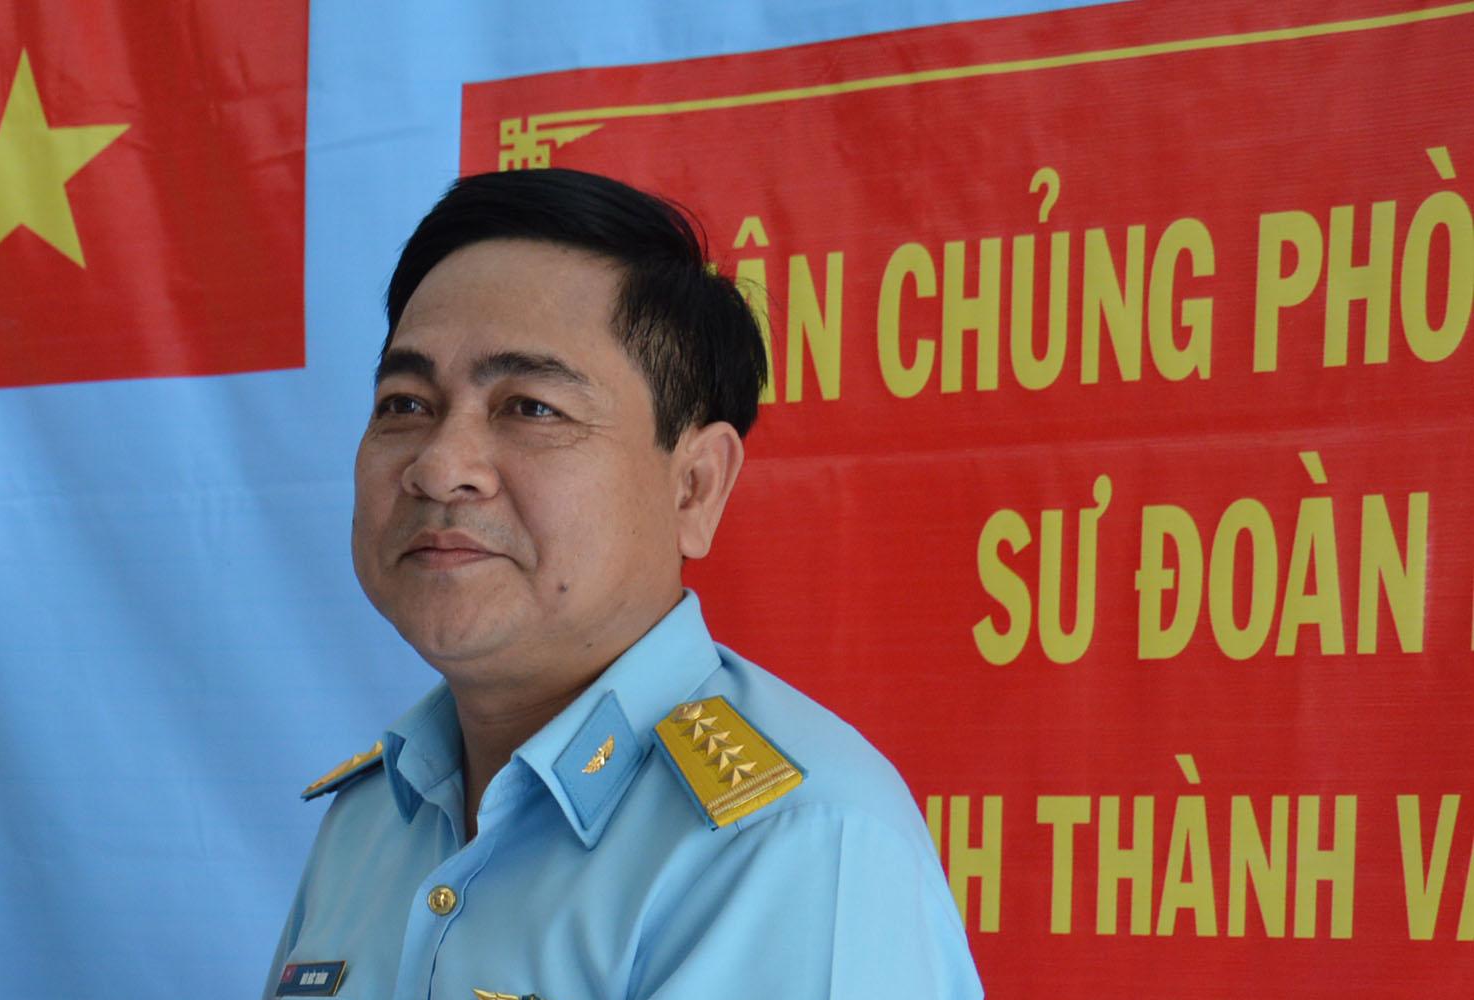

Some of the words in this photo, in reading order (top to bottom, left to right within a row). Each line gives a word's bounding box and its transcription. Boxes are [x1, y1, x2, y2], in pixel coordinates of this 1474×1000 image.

[704, 215, 845, 404] ÂN
[877, 167, 1216, 398] CHỦNG
[1253, 146, 1474, 372] PHÒ
[972, 475, 1113, 666] SƯ
[1135, 451, 1430, 660] ĐOÀN
[1037, 754, 1358, 939] THÀNH
